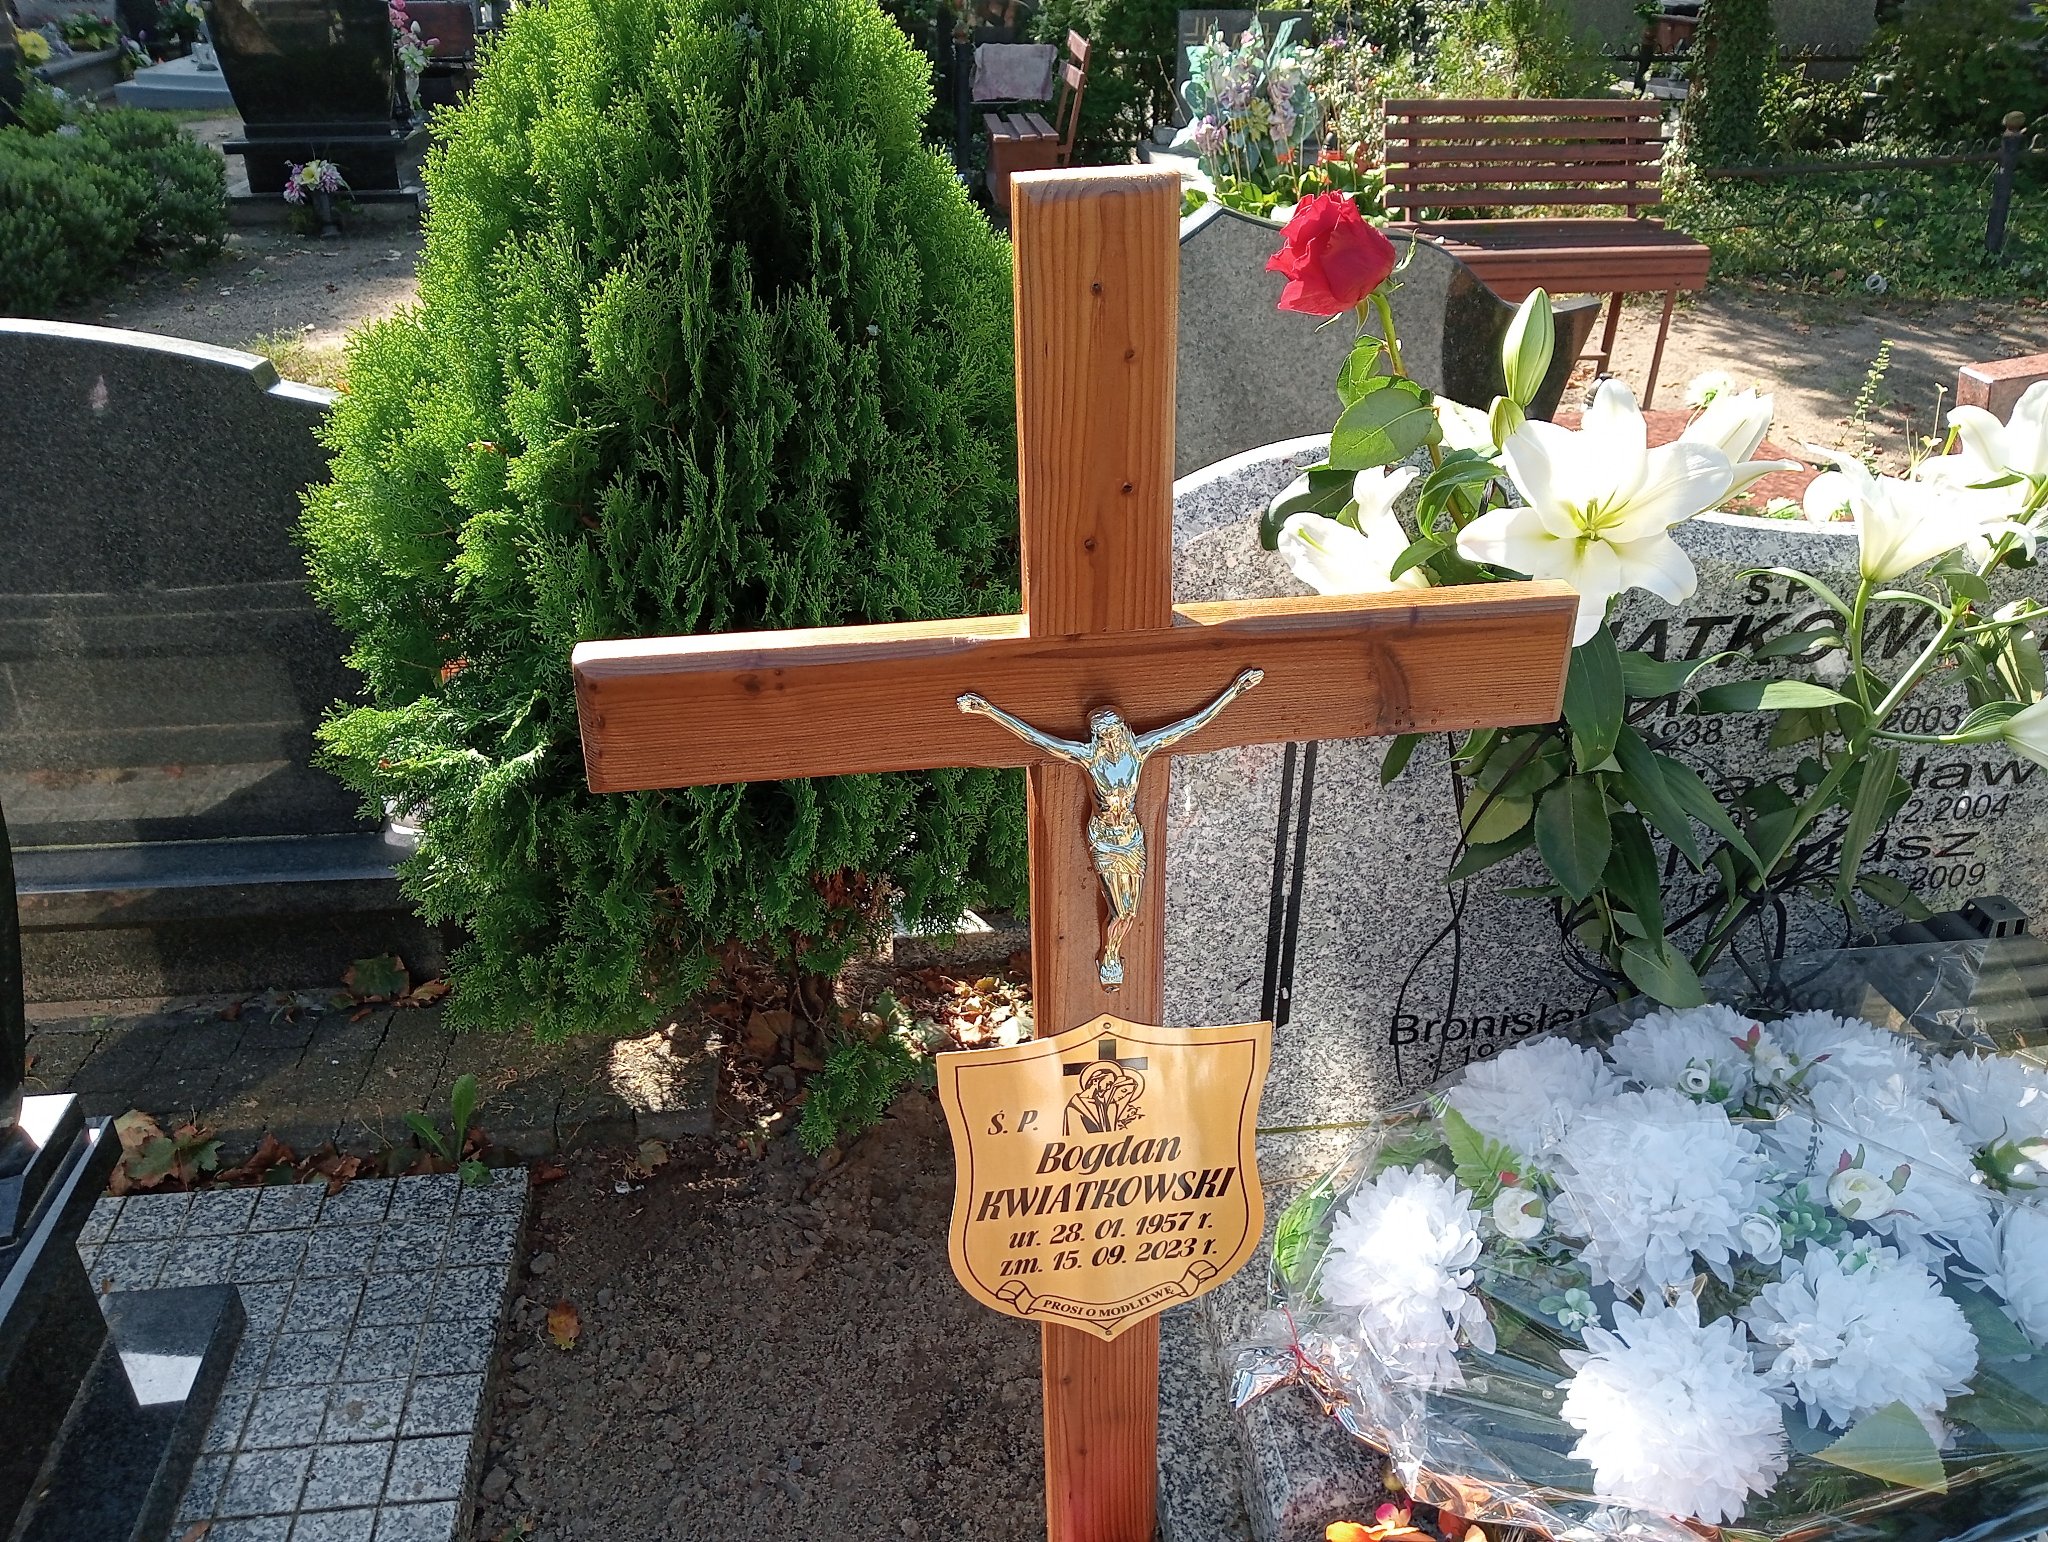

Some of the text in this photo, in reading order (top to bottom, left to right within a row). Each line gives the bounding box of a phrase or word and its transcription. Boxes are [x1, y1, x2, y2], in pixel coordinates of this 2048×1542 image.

[987, 1109, 1039, 1136] Ś. P.
[1035, 1134, 1182, 1176] Bogdan
[975, 1166, 1237, 1222] KWIATKOWSKI
[1008, 1211, 1213, 1249] ur. 28. 01. 1957 r.
[999, 1237, 1217, 1277] zm. 15. 09. 2023 r.
[1042, 1285, 1174, 1318] PROSI O MODLITWĘ
